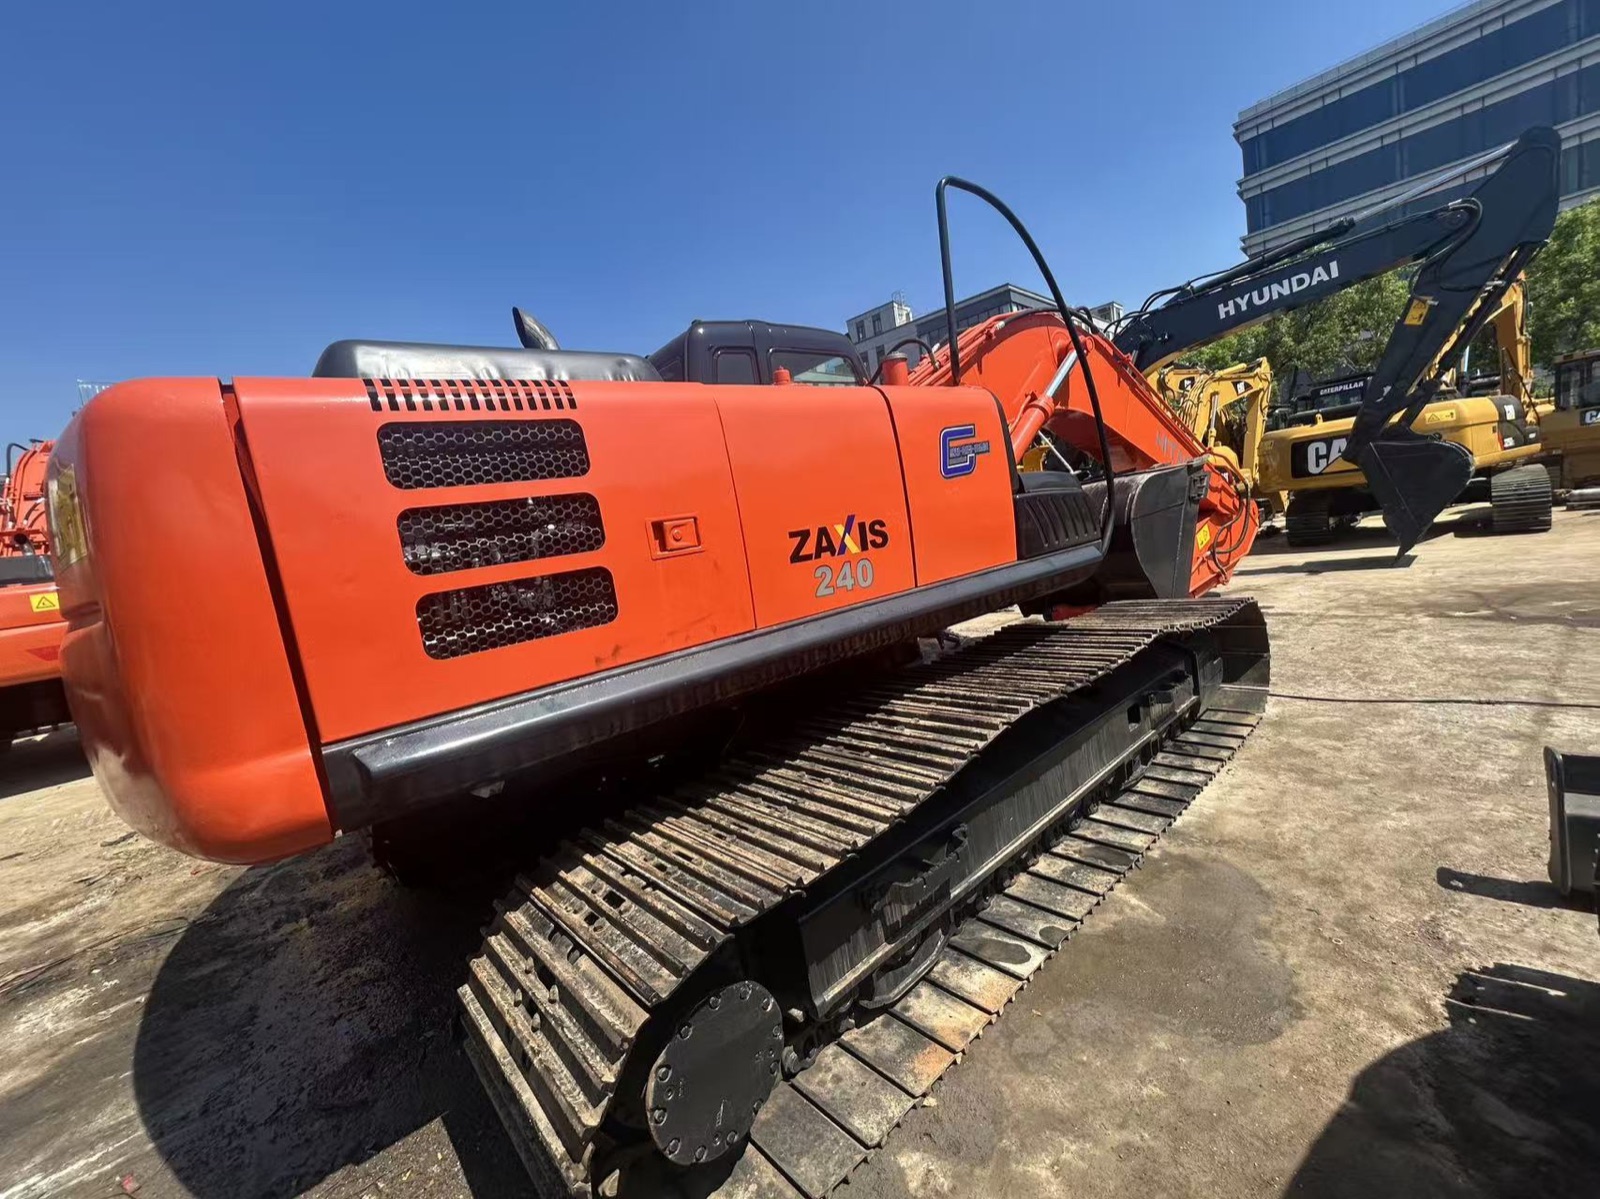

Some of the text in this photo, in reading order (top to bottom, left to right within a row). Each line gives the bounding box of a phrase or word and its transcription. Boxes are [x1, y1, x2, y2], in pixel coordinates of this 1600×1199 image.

[1218, 260, 1339, 319] HYUNDAI
[1319, 381, 1364, 395] CATERPILLAR
[1584, 410, 1600, 424] C
[788, 514, 889, 564] ZAXIS
[814, 558, 874, 597] 240
